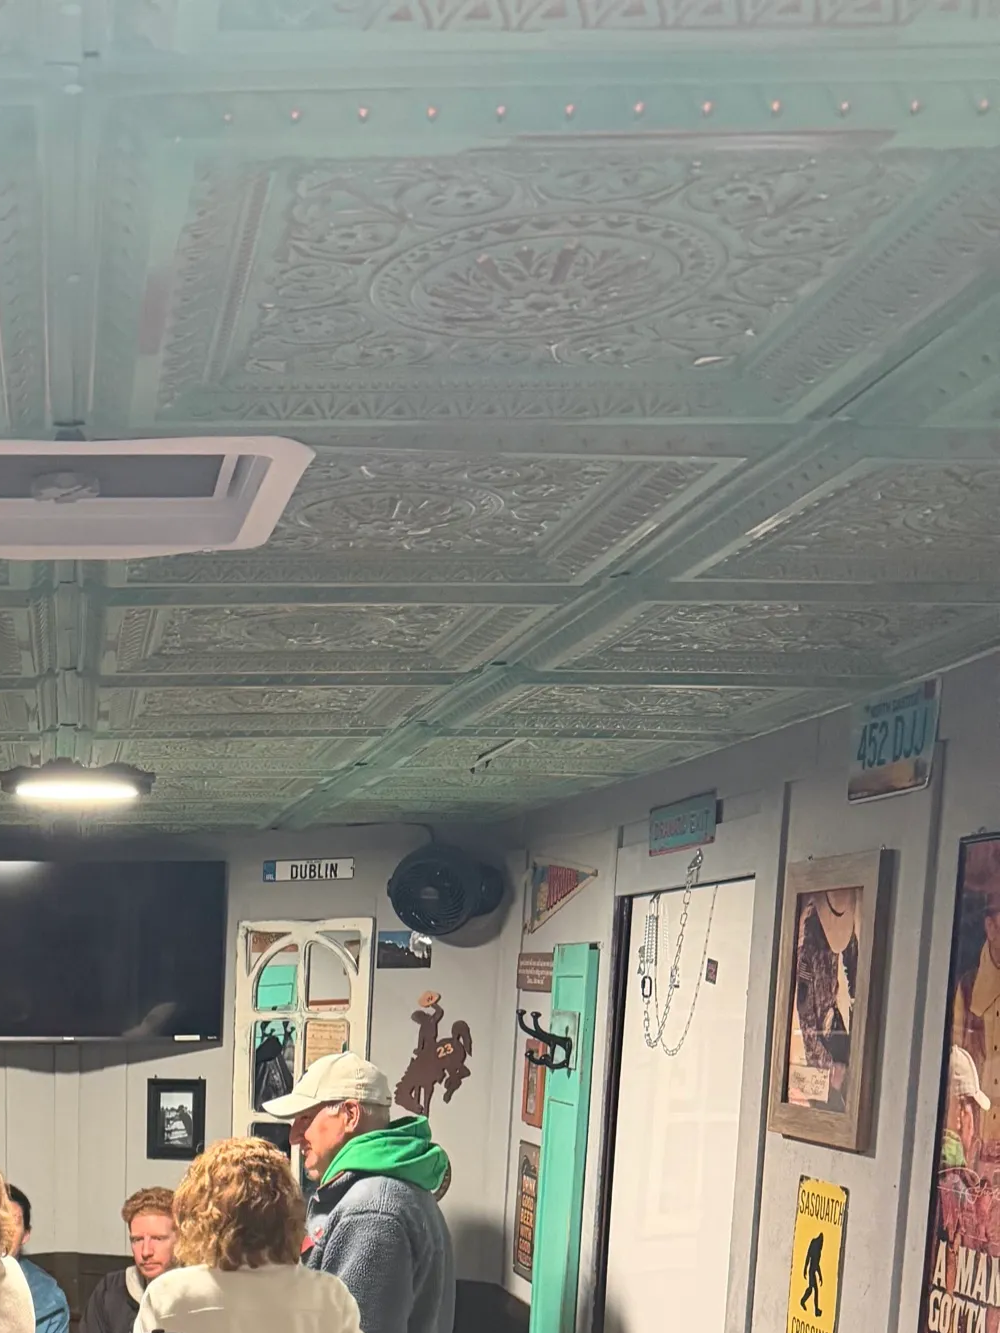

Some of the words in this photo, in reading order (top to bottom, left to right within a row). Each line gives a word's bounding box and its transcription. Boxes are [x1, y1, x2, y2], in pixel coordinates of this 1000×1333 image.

[857, 721, 888, 770] 452
[892, 706, 929, 762] DJJ
[290, 863, 338, 879] DUBLIN
[437, 1043, 454, 1058] 23
[800, 1189, 844, 1227] SASQUATCH
[932, 1241, 947, 1290] A
